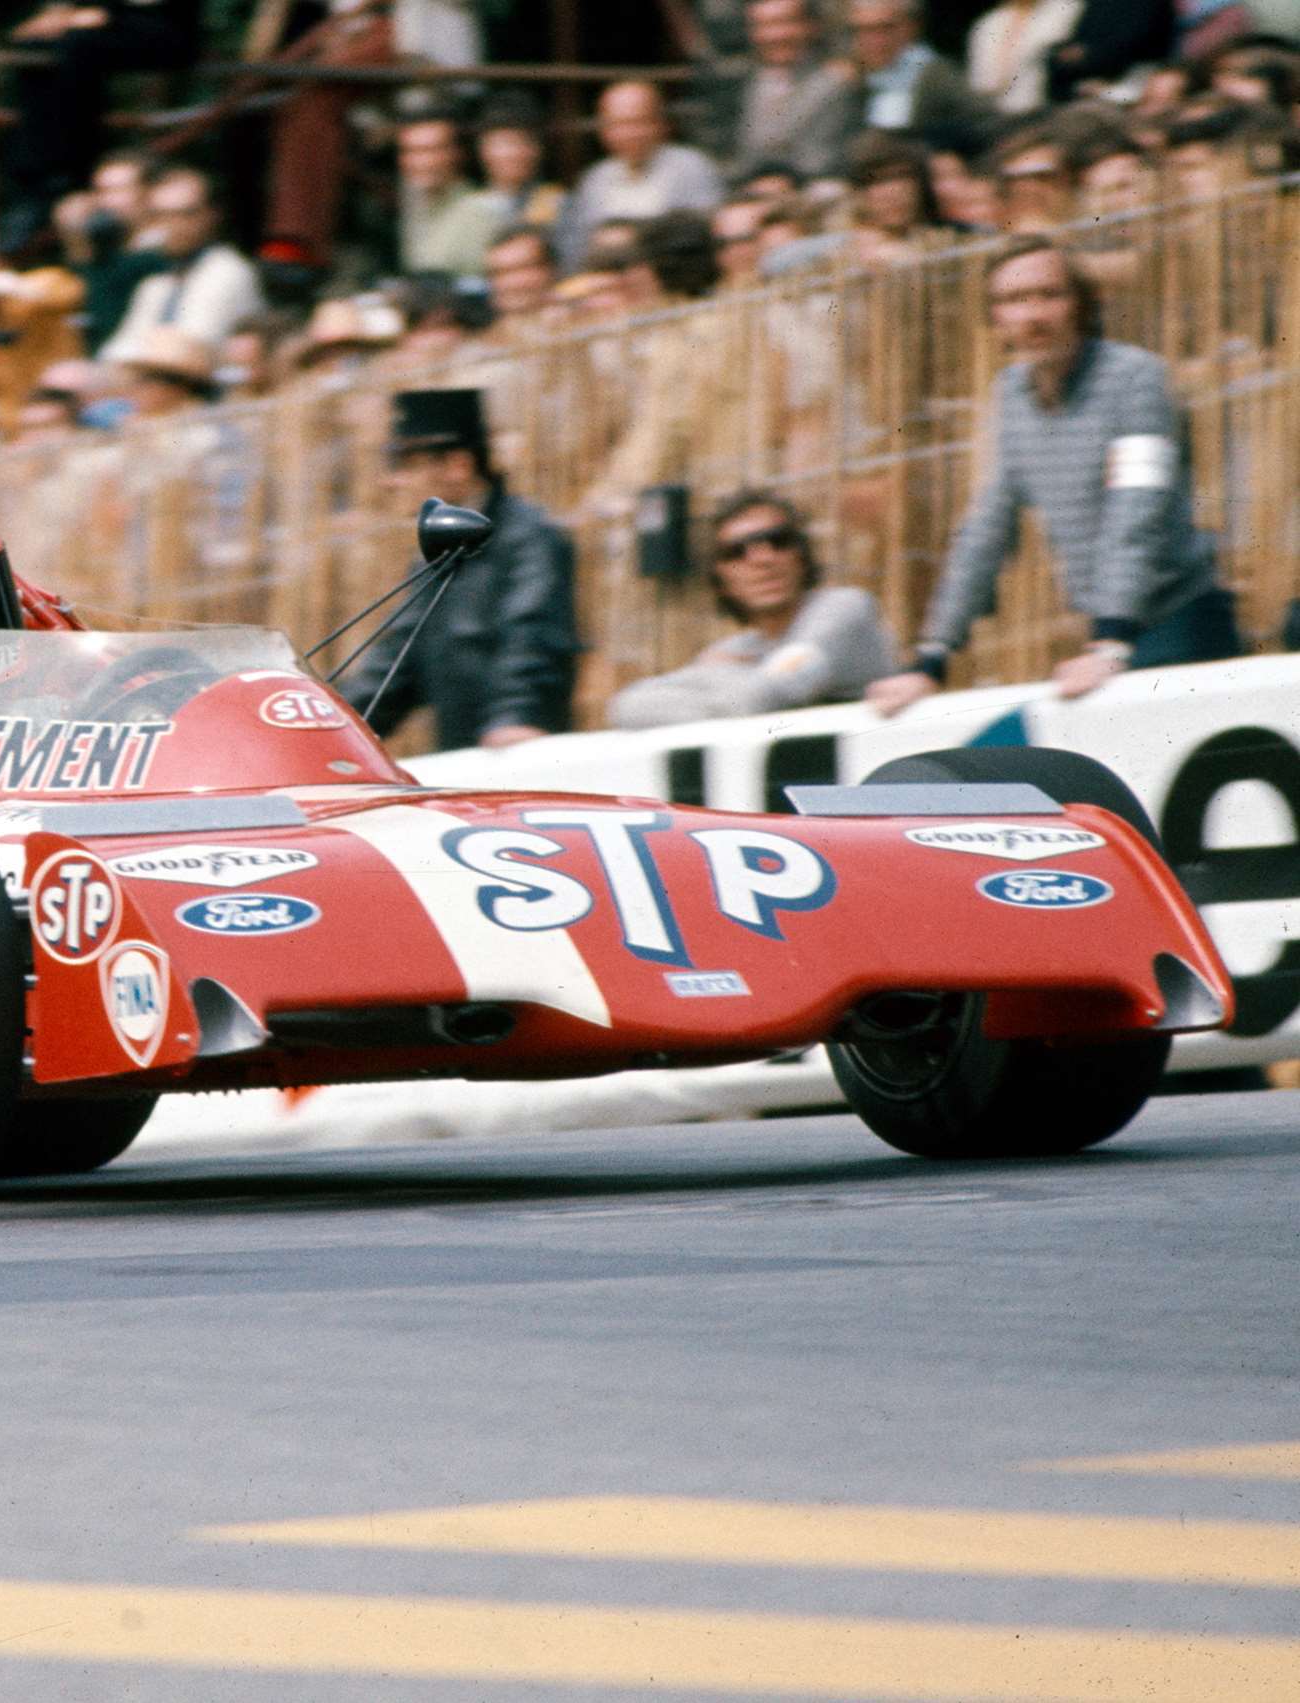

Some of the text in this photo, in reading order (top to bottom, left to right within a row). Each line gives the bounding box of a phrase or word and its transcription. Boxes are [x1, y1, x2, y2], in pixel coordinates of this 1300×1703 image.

[271, 692, 337, 720] STP
[912, 828, 1097, 850] GOODYEAR
[115, 850, 309, 877] GOODYEAR
[440, 810, 838, 969] STP
[1003, 874, 1089, 902] Ford
[40, 863, 113, 953] STP
[203, 897, 295, 929] Ford
